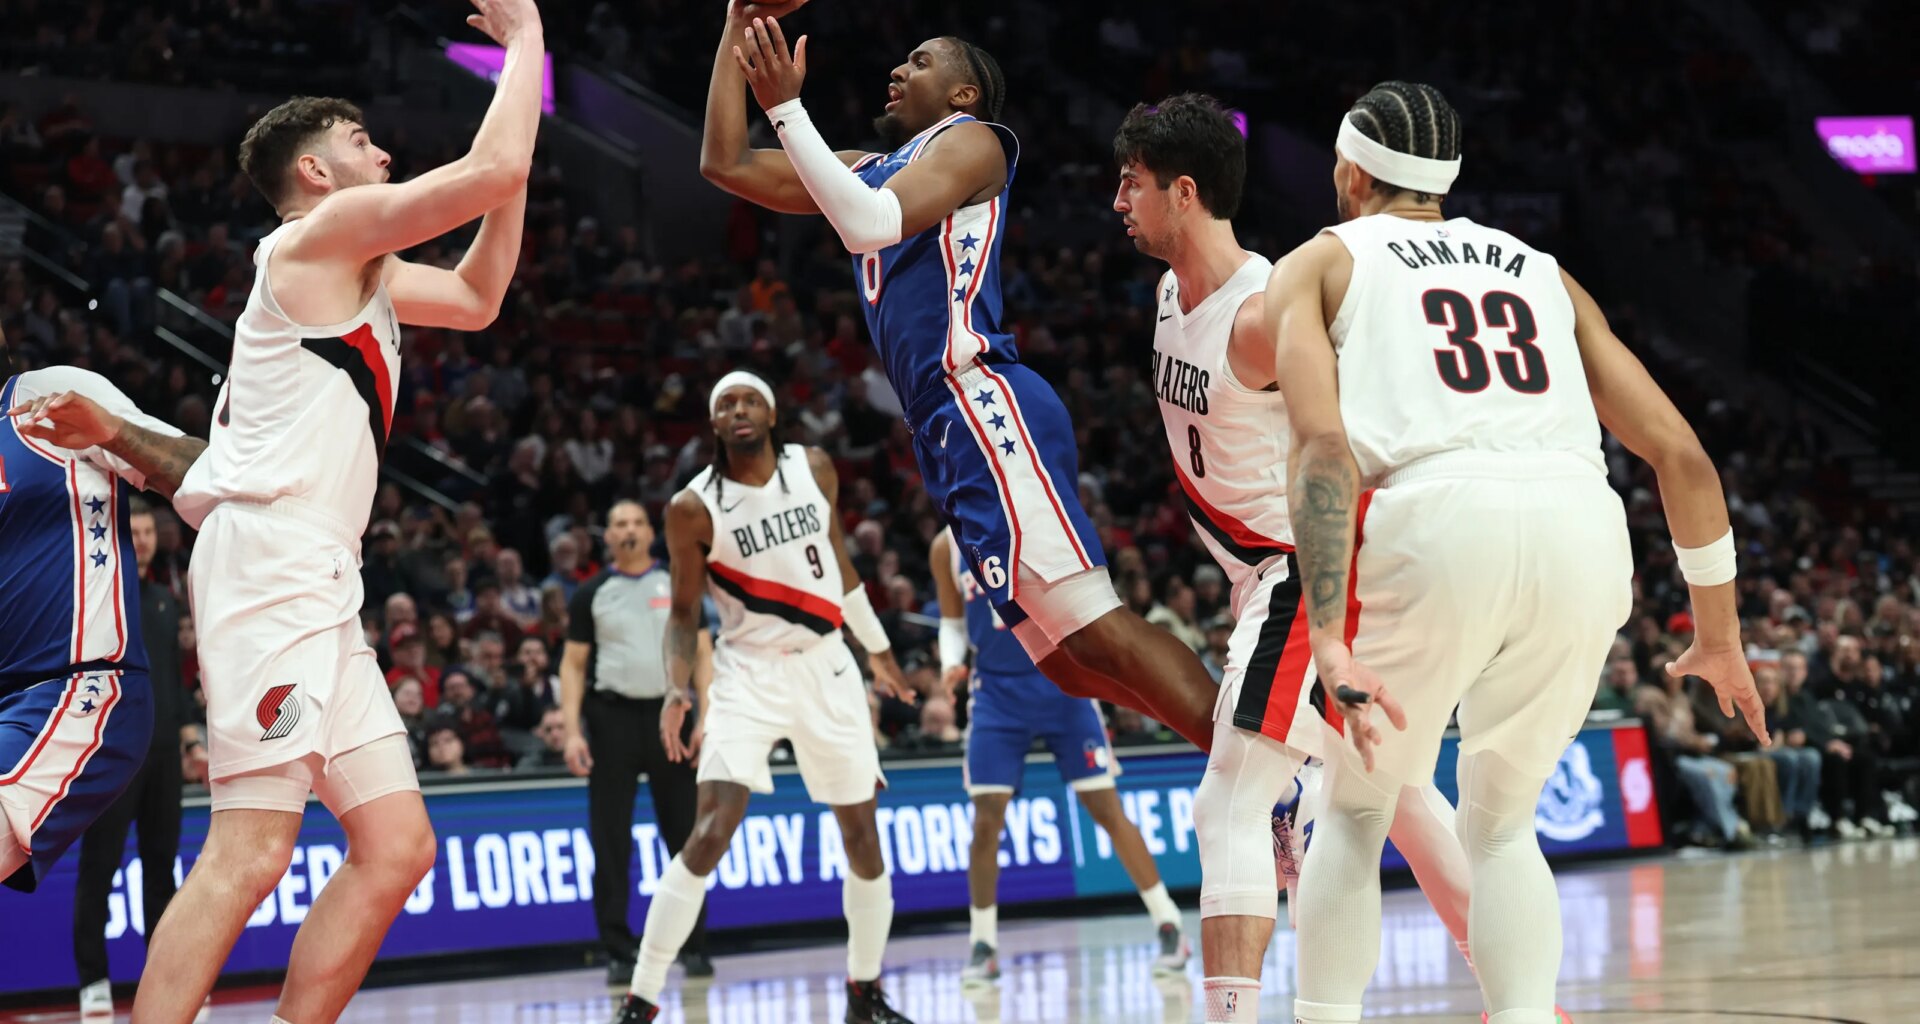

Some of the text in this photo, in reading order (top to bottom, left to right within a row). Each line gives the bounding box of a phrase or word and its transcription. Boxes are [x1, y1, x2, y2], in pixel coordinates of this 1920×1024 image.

[1387, 239, 1526, 278] CAMARA
[1421, 288, 1551, 394] 33
[1187, 424, 1206, 478] 8
[731, 503, 822, 558] BLAZERS
[805, 544, 824, 579] 9
[631, 812, 804, 896] IURY
[818, 797, 1063, 882] ATORNYS
